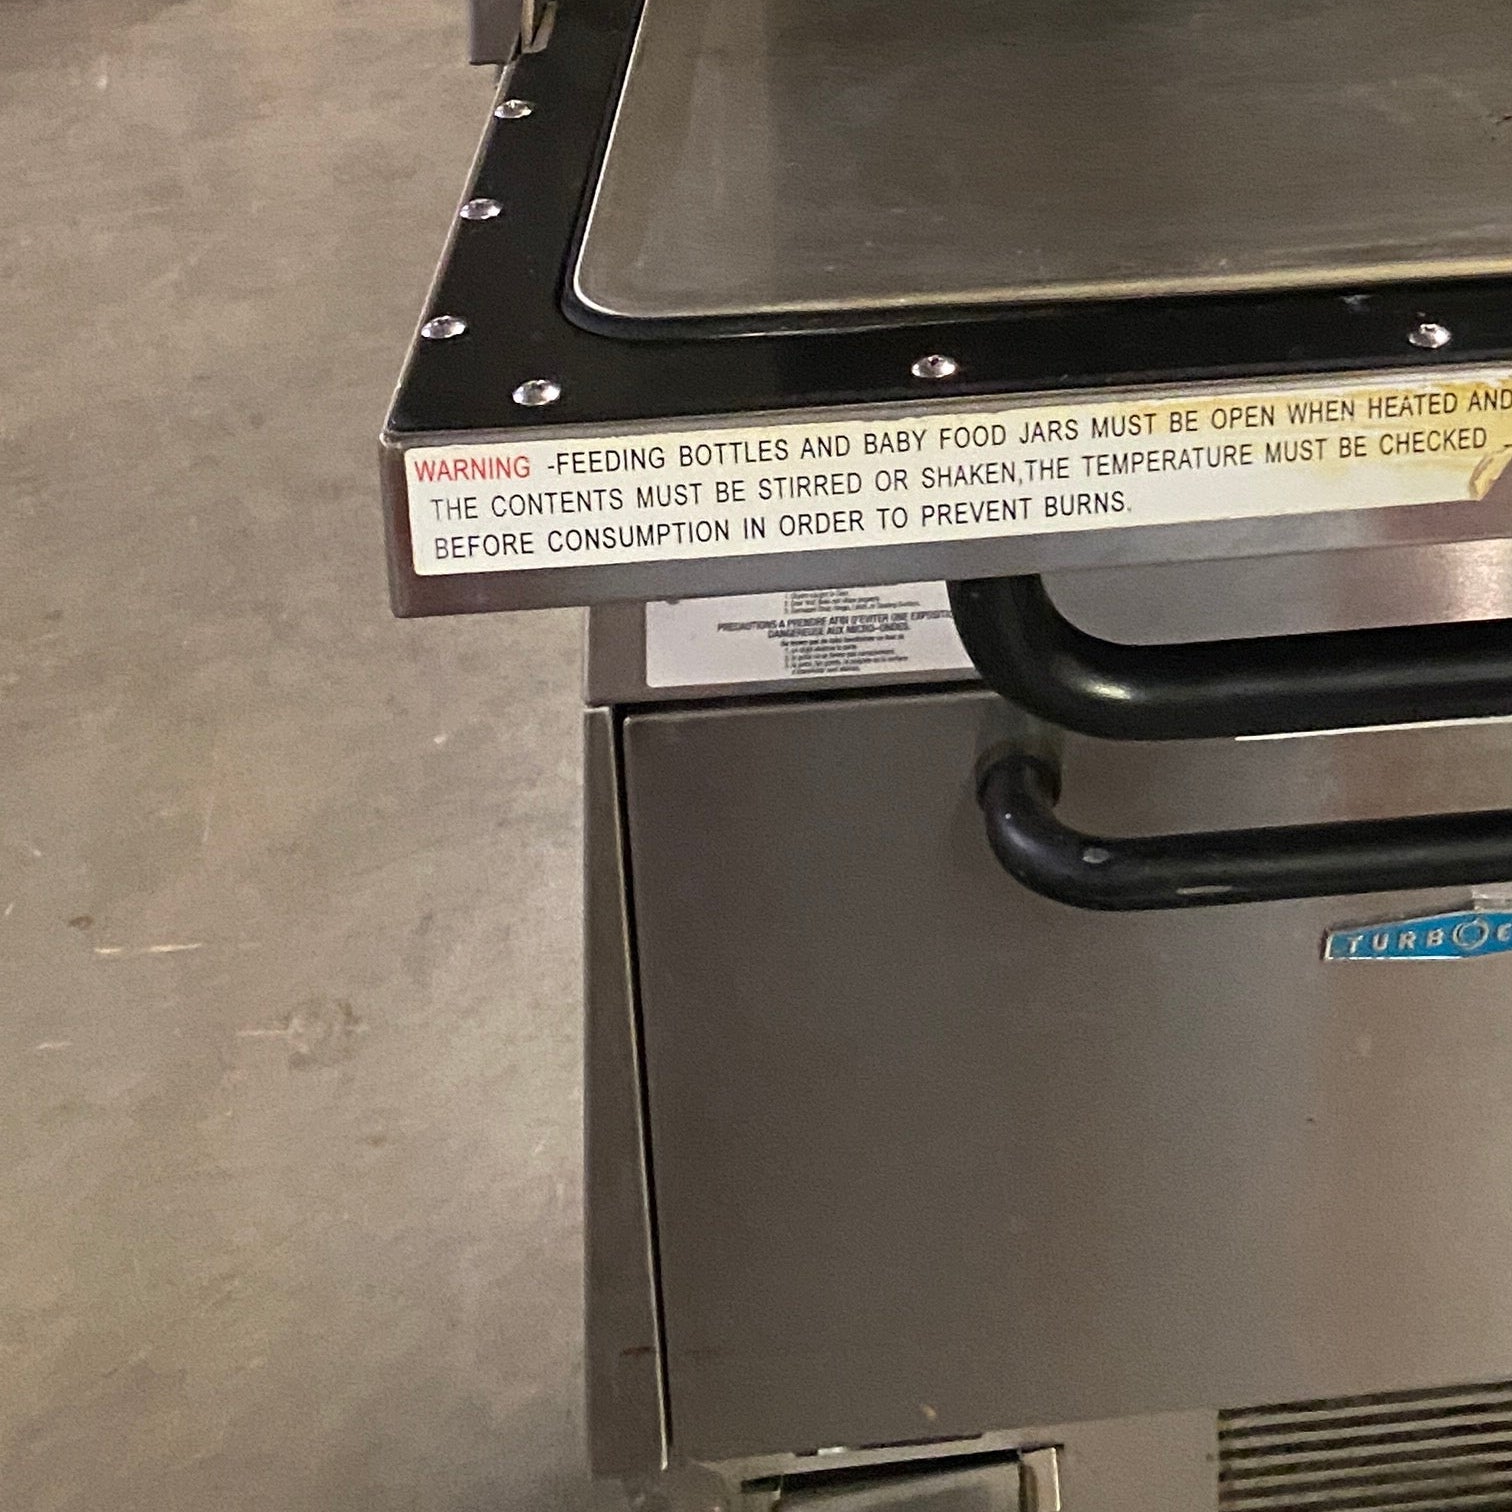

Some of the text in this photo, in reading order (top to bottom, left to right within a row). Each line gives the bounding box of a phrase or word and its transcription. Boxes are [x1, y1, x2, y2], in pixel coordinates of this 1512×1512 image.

[414, 455, 531, 483] WARNING
[679, 438, 788, 467] BOTTLES
[800, 435, 850, 460] AND
[864, 429, 927, 456] BABY
[939, 423, 1006, 450] FOOD
[1019, 418, 1079, 445] JARS
[1091, 413, 1156, 440] MUST
[1169, 410, 1199, 433] BE
[1210, 404, 1276, 430] OPEN
[1287, 399, 1355, 425] WHEN
[1368, 391, 1458, 419] HEATED
[431, 496, 478, 522] THE
[491, 487, 623, 519] CONTENTS
[636, 483, 702, 509] MUST
[716, 480, 746, 504] BE
[759, 471, 862, 501] STIRRED
[875, 468, 908, 492] OR
[1082, 443, 1253, 478] TEMPERATURE
[1265, 437, 1329, 464] MUST
[1339, 435, 1367, 459] BE
[1379, 426, 1488, 456] CHECKED
[434, 490, 1132, 560] BEFORE CONSUMPTION IN ORDER TO PREVENT BURNS.
